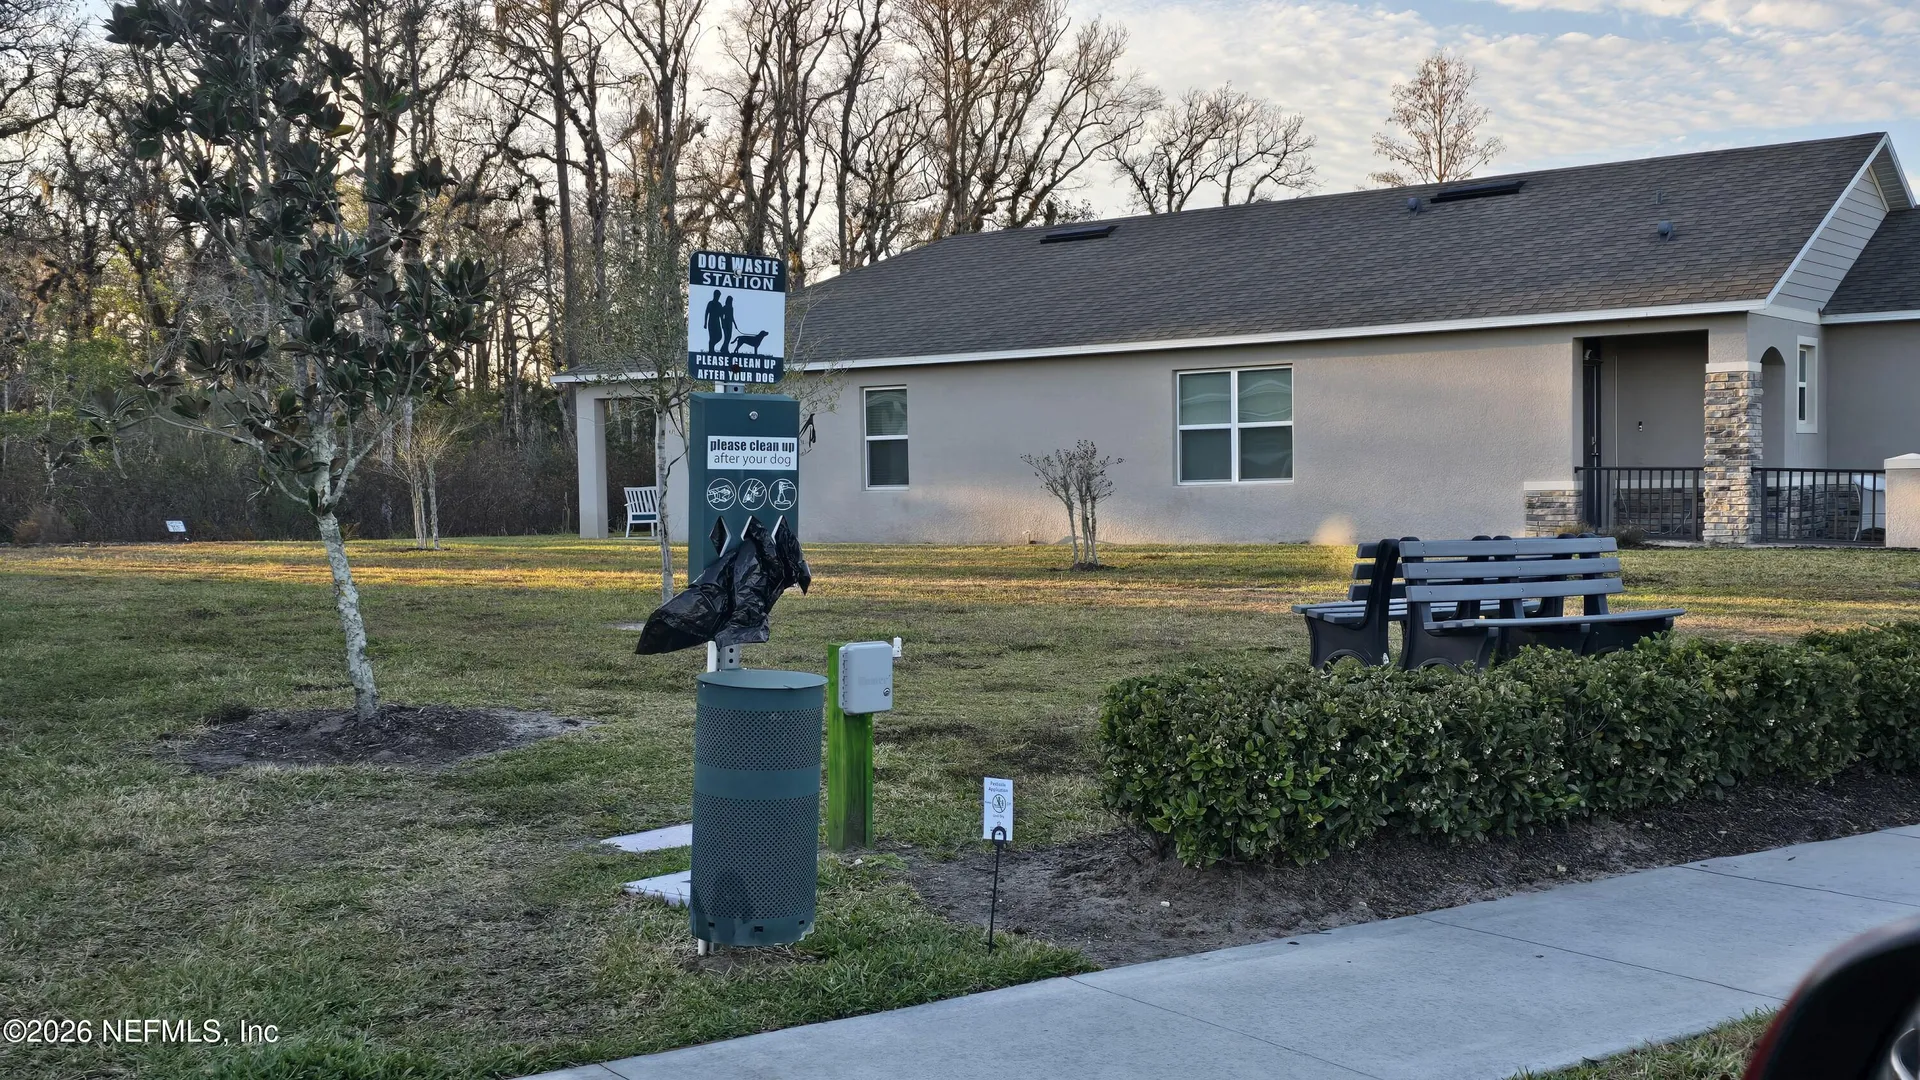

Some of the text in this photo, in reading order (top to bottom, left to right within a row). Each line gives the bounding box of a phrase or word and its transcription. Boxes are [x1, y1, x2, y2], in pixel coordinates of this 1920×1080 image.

[698, 253, 779, 275] DOG WASTE
[702, 272, 774, 290] STATION
[696, 354, 776, 370] PLEASE CLEAN UP
[697, 369, 774, 383] AFTER YOUR DOG
[710, 439, 795, 453] please clean up
[714, 452, 791, 467] after your dog
